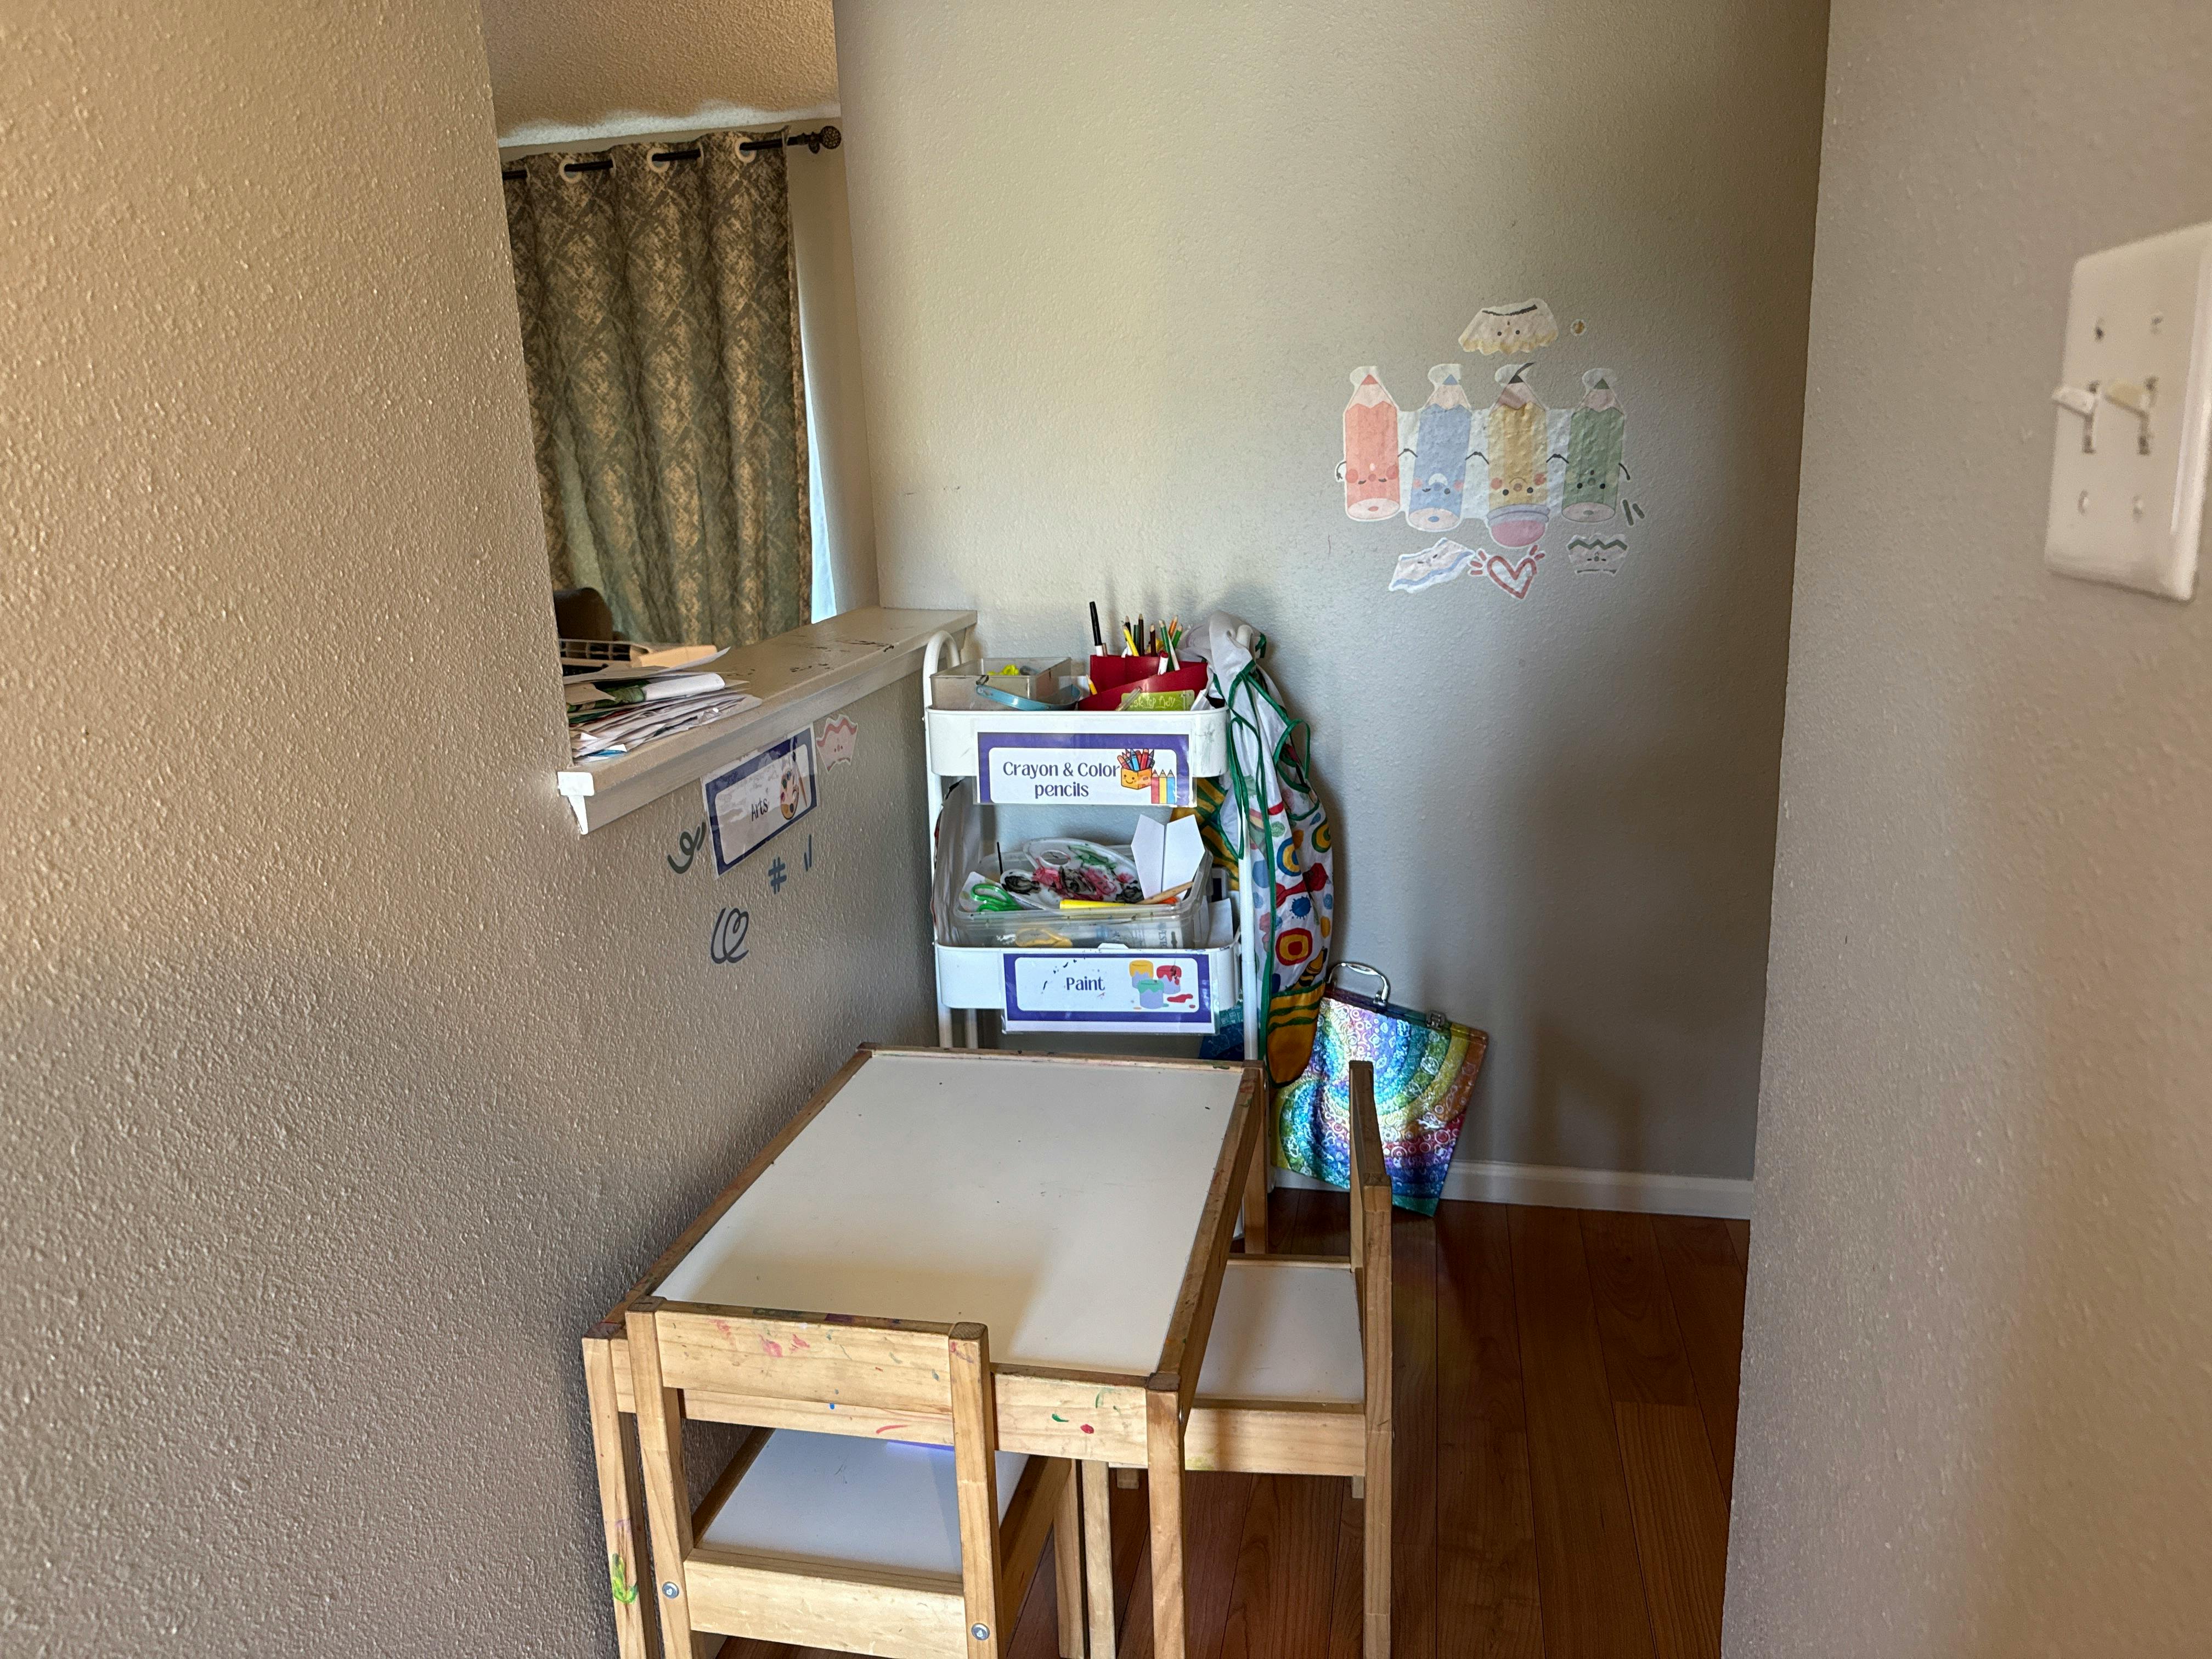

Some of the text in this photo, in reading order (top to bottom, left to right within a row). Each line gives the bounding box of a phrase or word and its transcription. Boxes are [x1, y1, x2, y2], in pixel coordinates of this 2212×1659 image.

[1003, 761, 1120, 779] Crayon & Color
[1035, 781, 1089, 799] pencils
[751, 797, 769, 822] Arts
[1066, 975, 1105, 991] Paint
